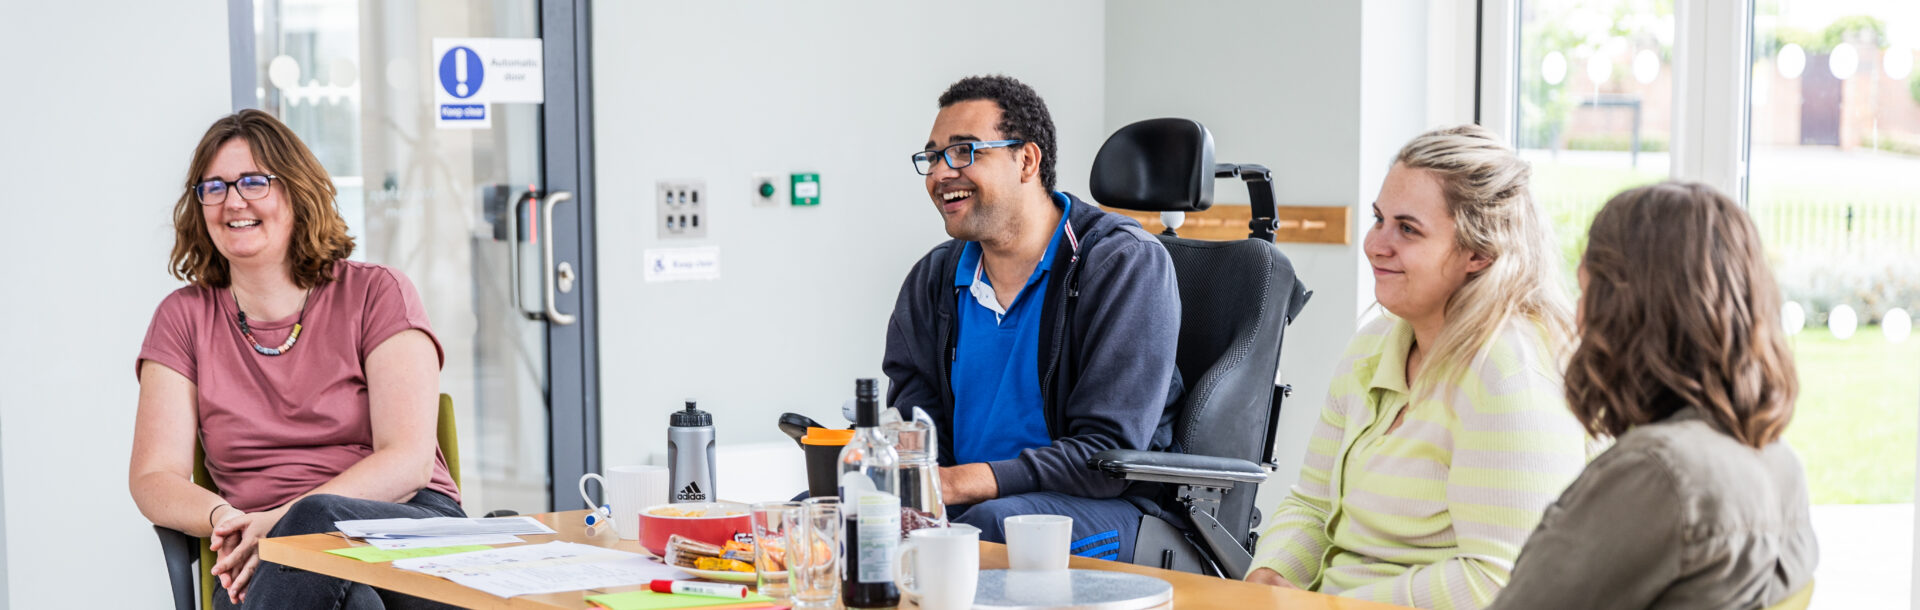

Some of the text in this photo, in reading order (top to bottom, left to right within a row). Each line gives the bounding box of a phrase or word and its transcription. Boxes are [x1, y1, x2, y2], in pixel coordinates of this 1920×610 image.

[490, 57, 537, 68] Automatic
[504, 72, 526, 81] door
[441, 106, 484, 118] Keep clear
[677, 493, 706, 501] adidas
